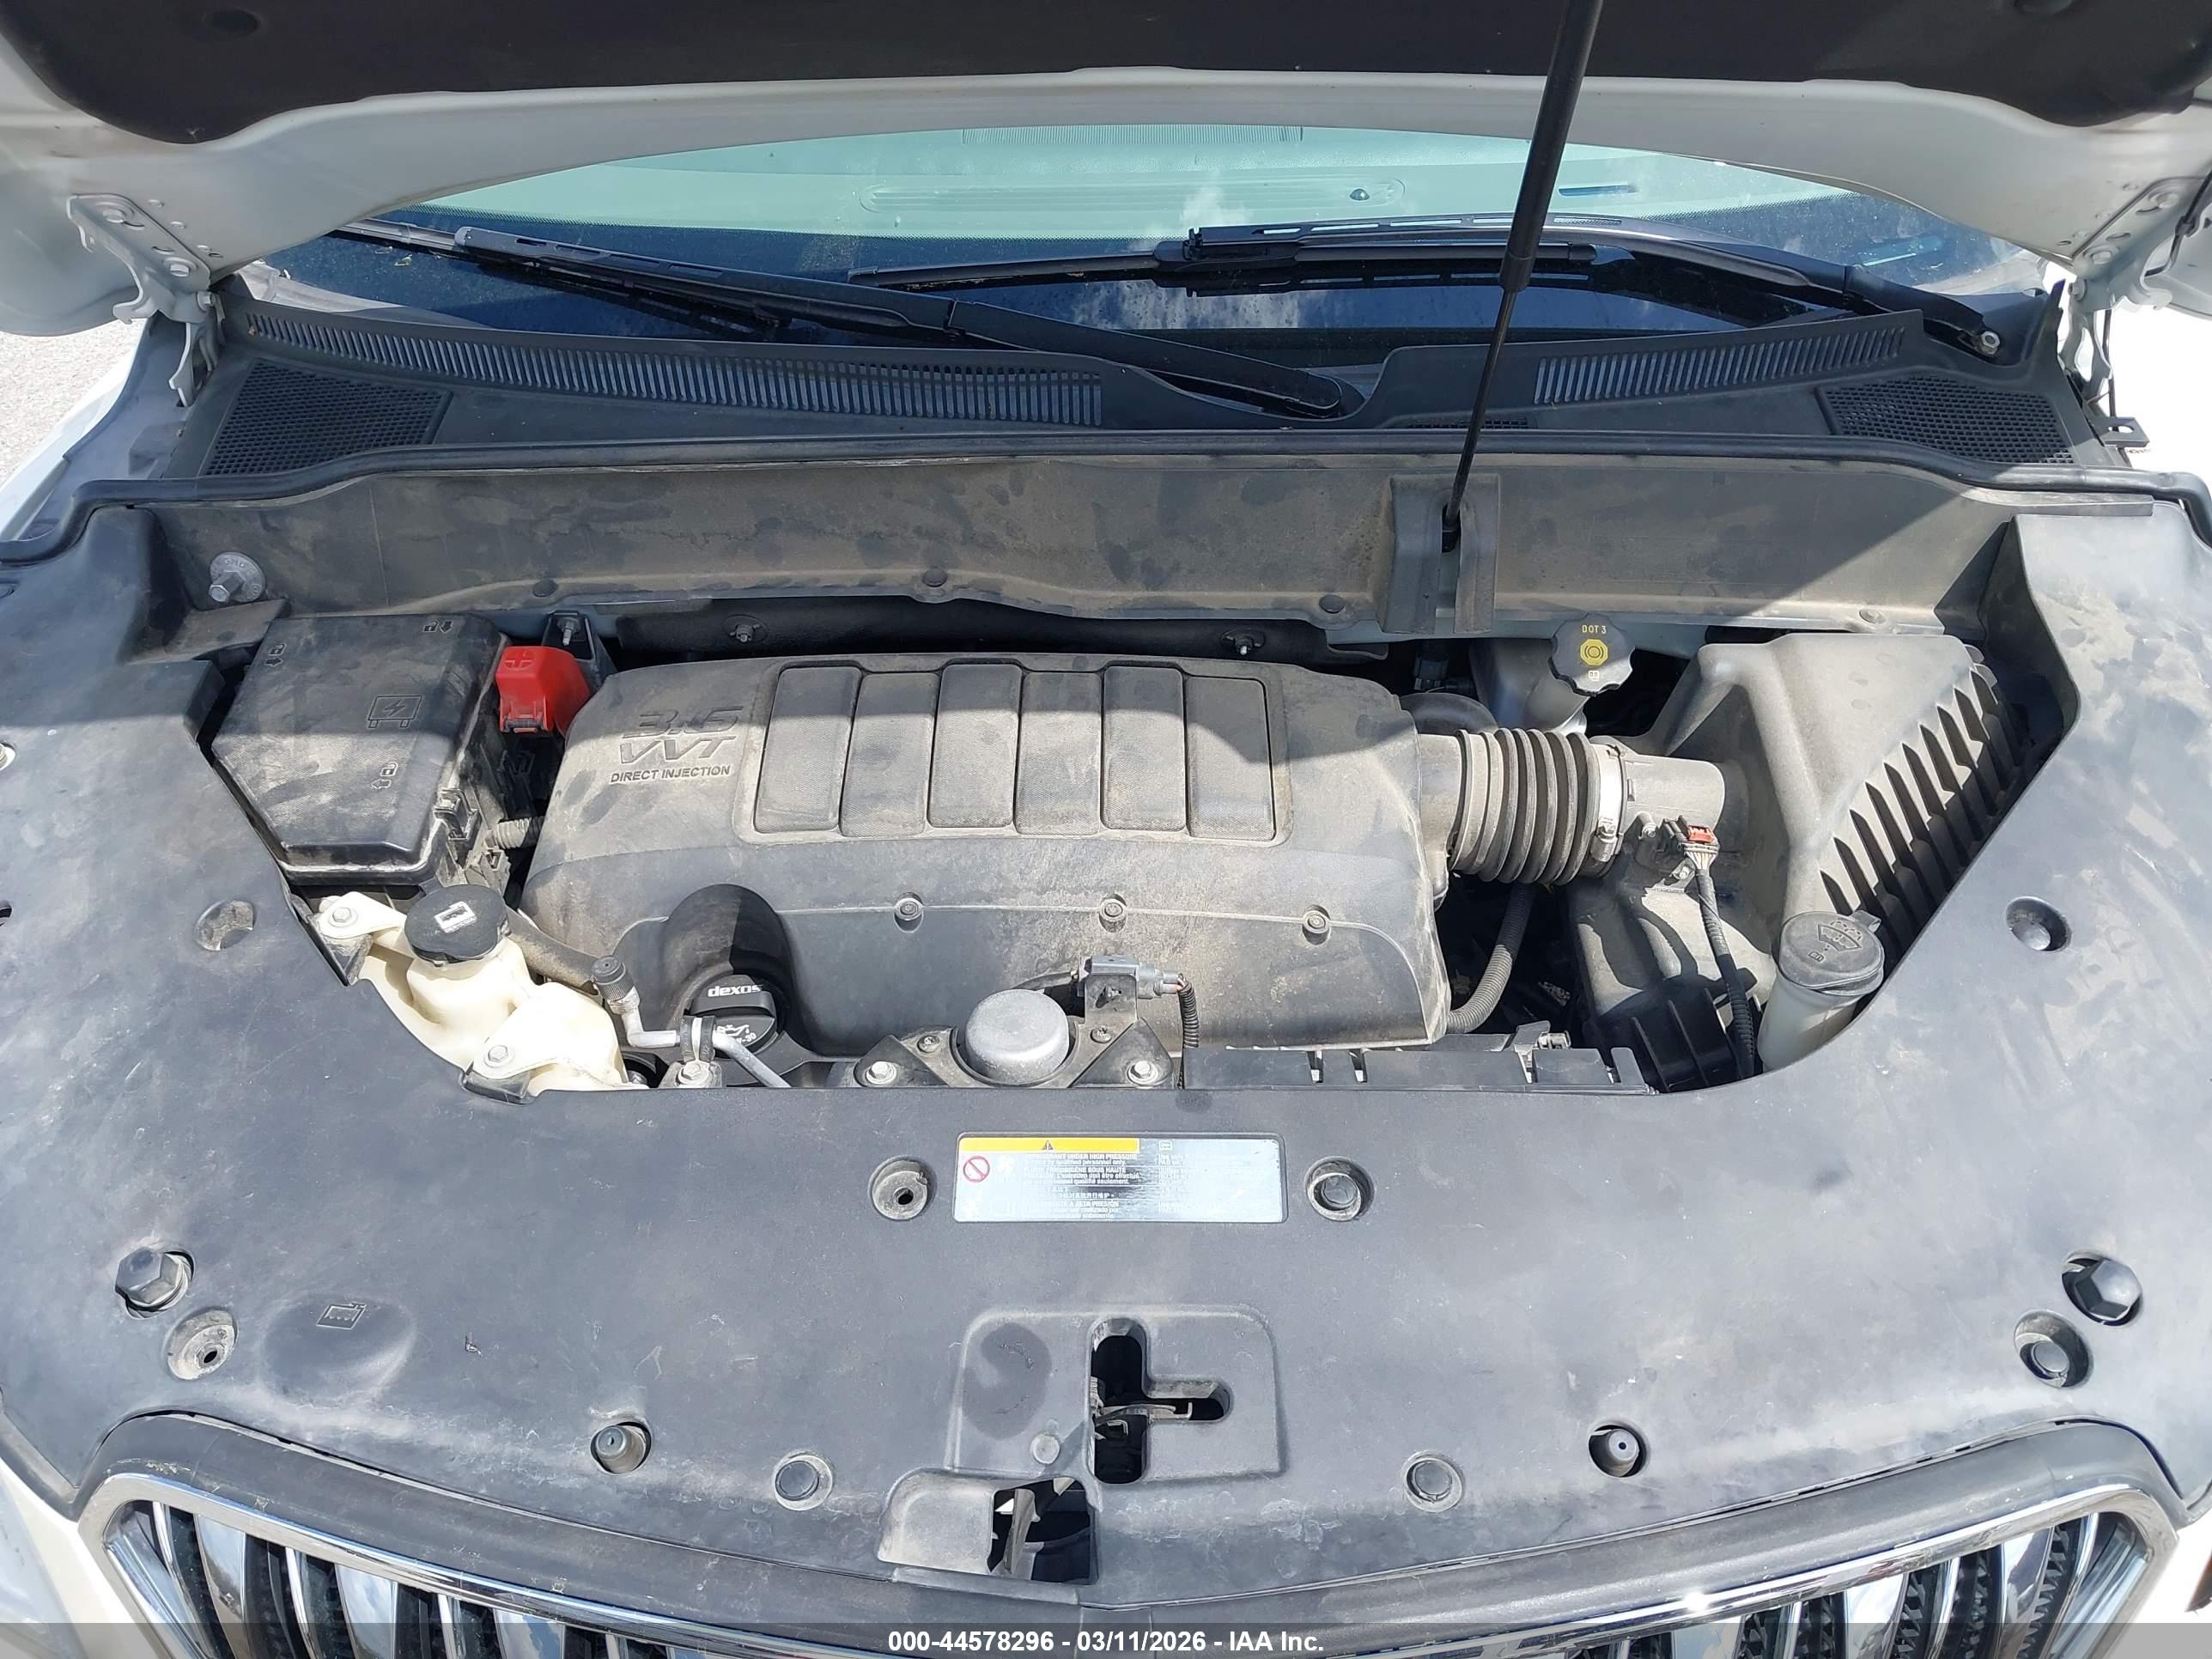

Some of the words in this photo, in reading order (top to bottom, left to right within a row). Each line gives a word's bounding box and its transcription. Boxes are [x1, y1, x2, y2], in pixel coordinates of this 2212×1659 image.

[1582, 624, 1599, 634] DOT
[1601, 624, 1607, 634] 3
[623, 706, 744, 739] 3.6
[620, 736, 737, 763] VVT
[611, 769, 659, 783] DIRECT
[661, 765, 730, 779] INJECTION
[708, 984, 762, 997] dexos
